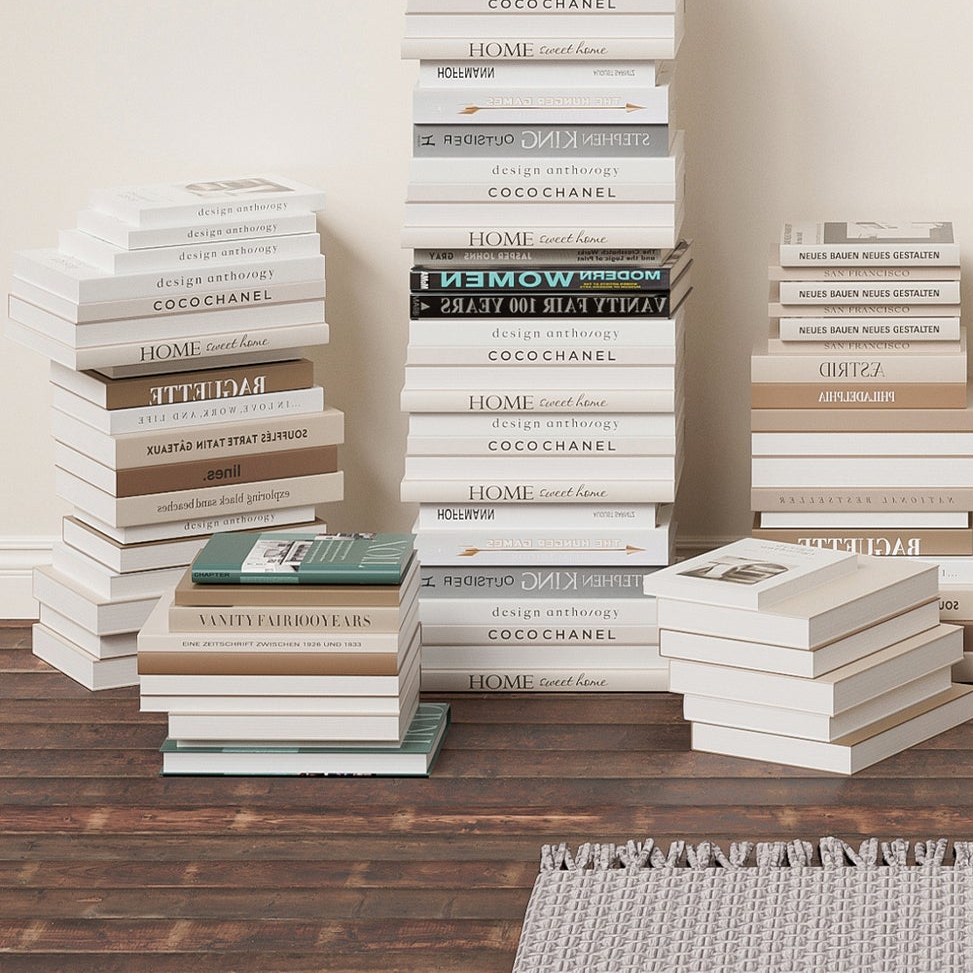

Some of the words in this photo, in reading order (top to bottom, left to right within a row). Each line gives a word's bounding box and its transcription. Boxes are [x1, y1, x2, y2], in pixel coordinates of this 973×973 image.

[469, 42, 535, 58] HOME
[539, 45, 574, 56] sweet
[575, 41, 609, 56] home
[491, 165, 541, 178] design
[546, 165, 620, 178] anthology
[197, 204, 233, 218] design
[236, 200, 288, 215] anthology
[186, 225, 223, 239] design
[225, 221, 279, 236] anthology
[469, 231, 535, 247] HOME
[539, 234, 574, 245] sweet
[575, 230, 609, 245] home
[179, 248, 217, 262] design
[220, 243, 279, 259] anthology
[799, 251, 827, 260] NEUES
[830, 251, 859, 260] BAUEN
[862, 251, 890, 260] NEUES
[893, 251, 940, 260] GESTALTEN
[156, 272, 203, 289] design
[207, 267, 276, 284] anthology
[824, 269, 845, 278] SAN
[848, 269, 910, 278] FRANCISCO
[799, 289, 827, 298] NEUES
[830, 289, 859, 298] BAUEN
[862, 289, 890, 298] NEUES
[893, 289, 940, 298] GESTALTEN
[824, 305, 845, 314] SAN
[848, 305, 910, 314] FRANCISCO
[491, 328, 541, 341] design
[546, 328, 620, 341] anthology
[799, 325, 827, 335] NEUES
[830, 325, 859, 335] BAUEN
[862, 325, 890, 335] NEUES
[893, 325, 940, 335] GESTALTEN
[139, 340, 201, 362] HOME
[205, 338, 237, 353] sweet
[238, 334, 270, 349] home
[824, 341, 845, 350] SAN
[848, 341, 910, 350] FRANCISCO
[469, 395, 535, 411] HOME
[539, 398, 574, 408] sweet
[575, 393, 609, 408] home
[491, 418, 541, 431] design
[546, 418, 620, 431] anthology
[469, 485, 535, 501] HOME
[539, 488, 574, 499] sweet
[575, 484, 609, 499] home
[183, 518, 221, 532] design
[491, 607, 541, 620] design
[546, 607, 620, 620] anthology
[199, 614, 254, 627] VANITY
[469, 674, 535, 690] HOME
[539, 677, 574, 687] sweet
[575, 672, 609, 687] home
